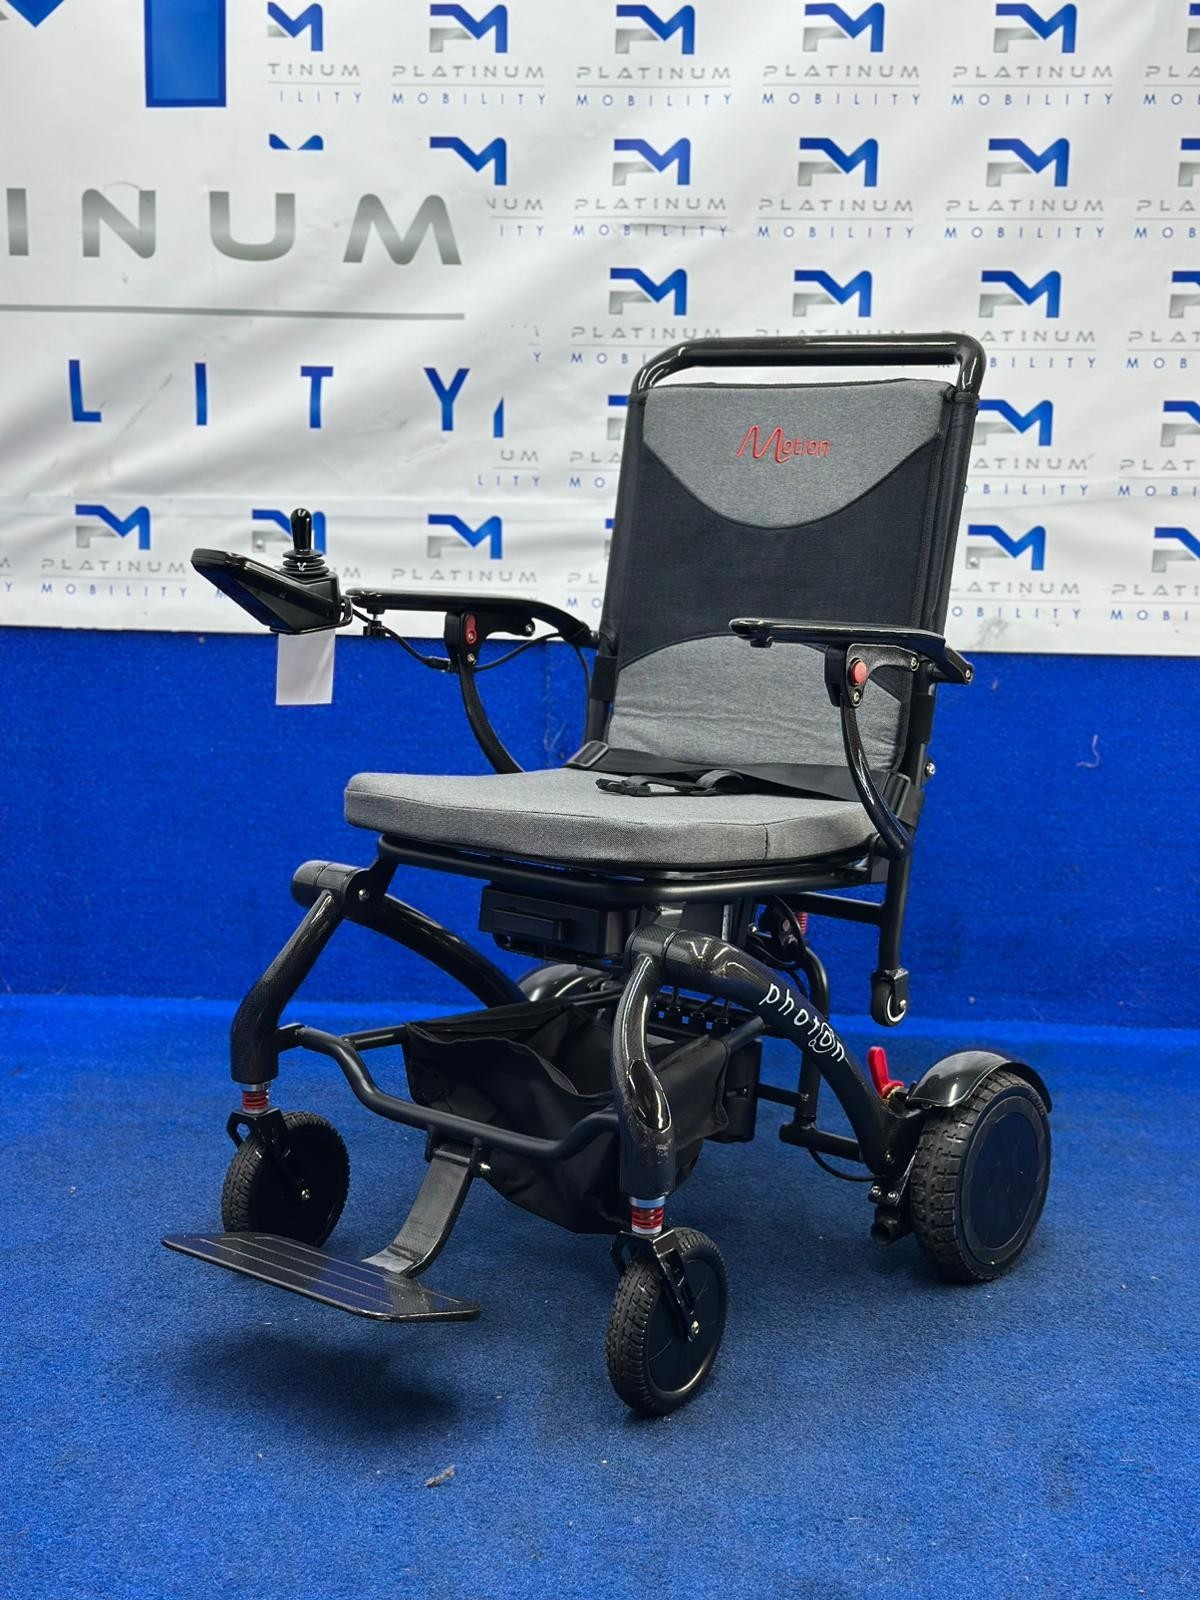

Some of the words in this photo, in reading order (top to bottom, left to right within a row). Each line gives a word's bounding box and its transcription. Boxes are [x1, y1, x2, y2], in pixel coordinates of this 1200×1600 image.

[392, 65, 544, 79] PLATINUM
[576, 67, 731, 80] PLATINUM
[763, 65, 920, 78] PLATINUM
[952, 65, 1112, 78] PLATINUM
[392, 93, 545, 105] MOBILITY
[576, 95, 732, 107] MOBILITY
[762, 93, 921, 106] MOBILITY
[951, 94, 1113, 106] MOBILITY
[574, 198, 727, 211] PLATINUM
[758, 199, 914, 212] PLATINUM
[945, 199, 1104, 212] PLATINUM
[572, 224, 728, 237] MOBILITY
[757, 226, 914, 239] MOBILITY
[944, 226, 1105, 239] MOBILITY
[571, 326, 722, 339] PLATINUM
[736, 424, 831, 464] Motion
[41, 558, 186, 573] PLATINUM
[391, 567, 537, 583] PLATINUM
[41, 583, 187, 598] MOBILITY
[758, 983, 845, 1062] photon
